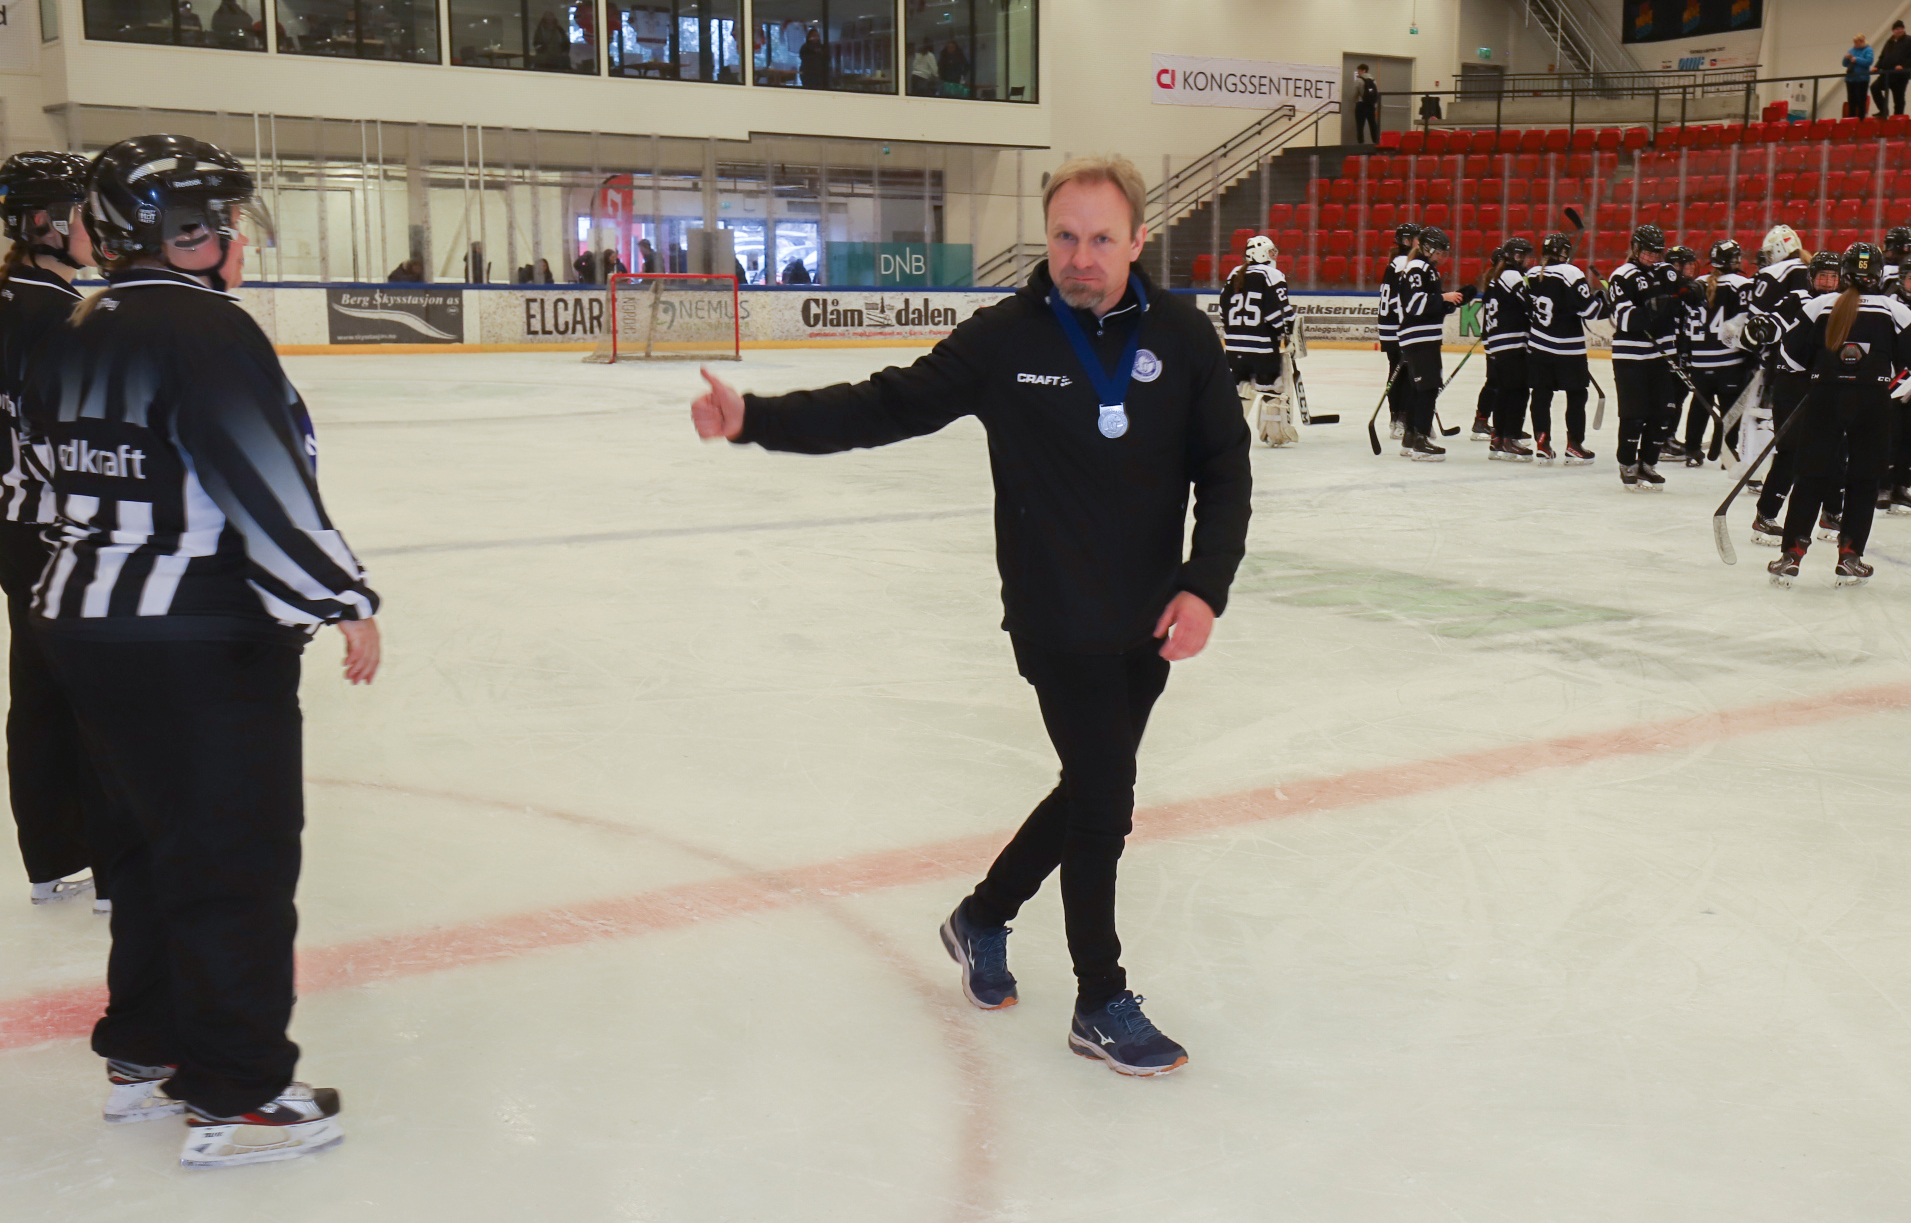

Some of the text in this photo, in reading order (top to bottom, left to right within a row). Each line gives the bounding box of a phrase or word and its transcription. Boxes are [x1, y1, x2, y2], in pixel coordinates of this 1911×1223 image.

[1183, 71, 1336, 99] KONGSSENTERET
[881, 246, 926, 282] DNB
[1858, 260, 1868, 269] 65
[341, 291, 460, 307] Berg Skysstasjon as
[679, 300, 750, 319] NEMUS
[801, 298, 957, 328] Glåm dalen
[1228, 291, 1262, 326] 25
[1017, 373, 1062, 386] CRAFT
[1297, 381, 1309, 424] CCM
